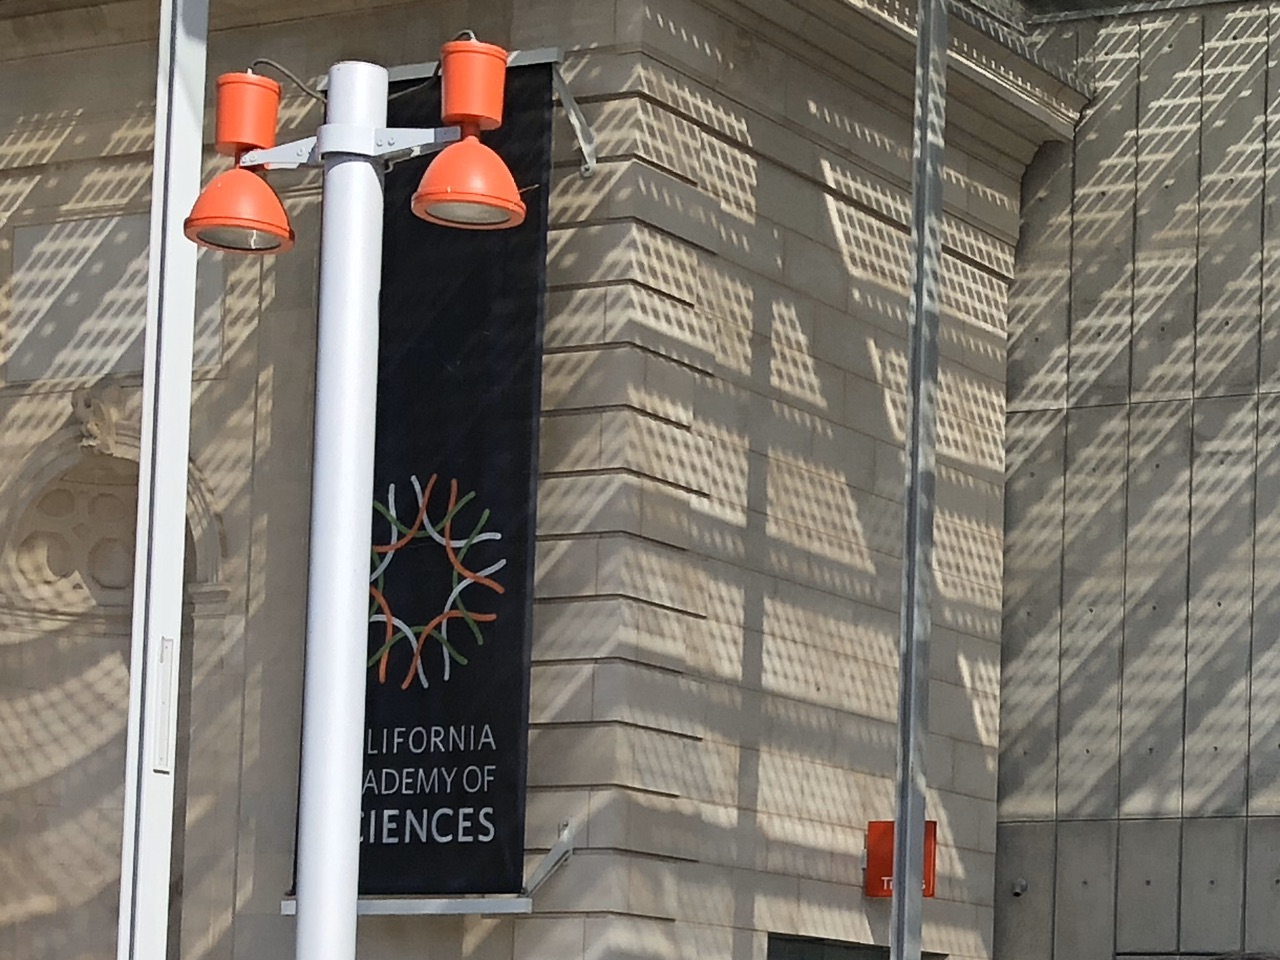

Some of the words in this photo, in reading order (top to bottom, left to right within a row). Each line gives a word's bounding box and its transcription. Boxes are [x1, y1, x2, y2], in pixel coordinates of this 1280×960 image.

[367, 724, 497, 754] LIFORNIA
[362, 766, 457, 795] ADEMY
[462, 765, 496, 792] OF
[361, 807, 495, 843] IENCES
